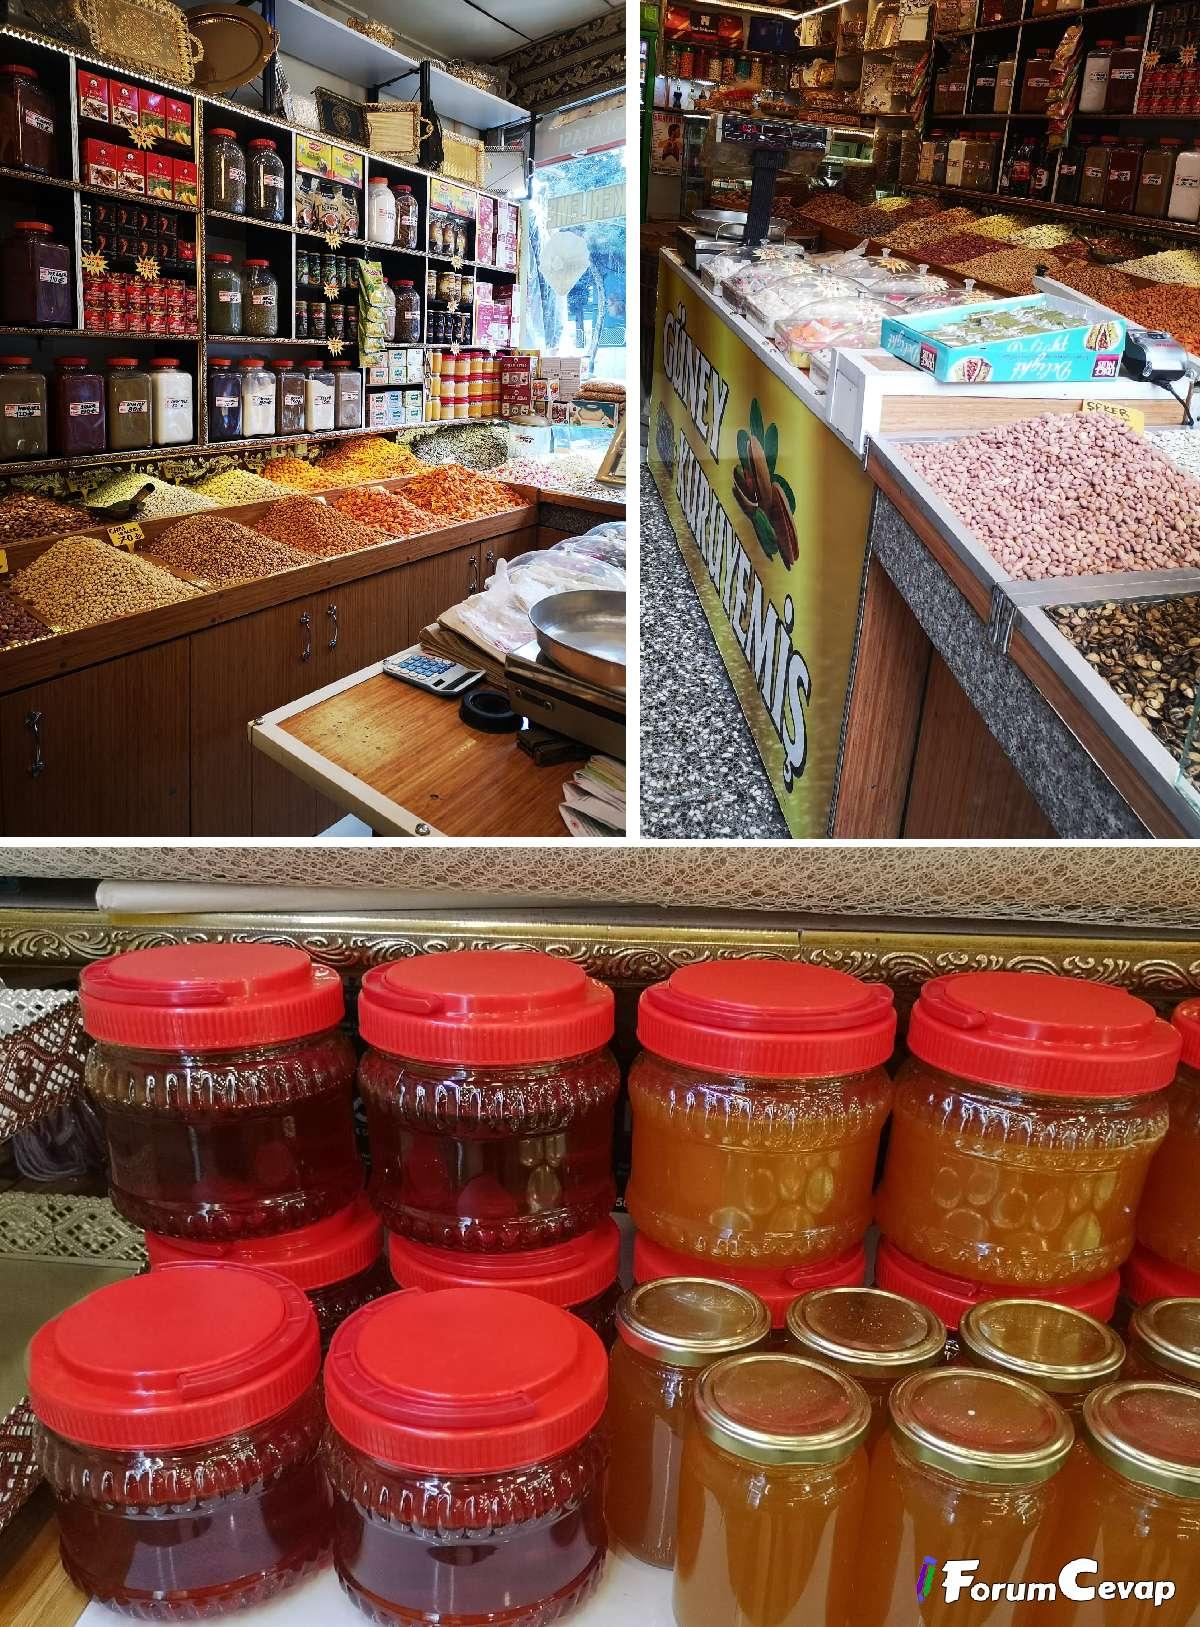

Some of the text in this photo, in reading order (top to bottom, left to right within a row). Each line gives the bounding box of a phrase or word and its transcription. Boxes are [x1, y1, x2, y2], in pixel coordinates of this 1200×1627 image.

[663, 304, 729, 463] GÜNEY
[1008, 352, 1073, 381] Delight
[675, 429, 811, 793] KURUYEMİŞ
